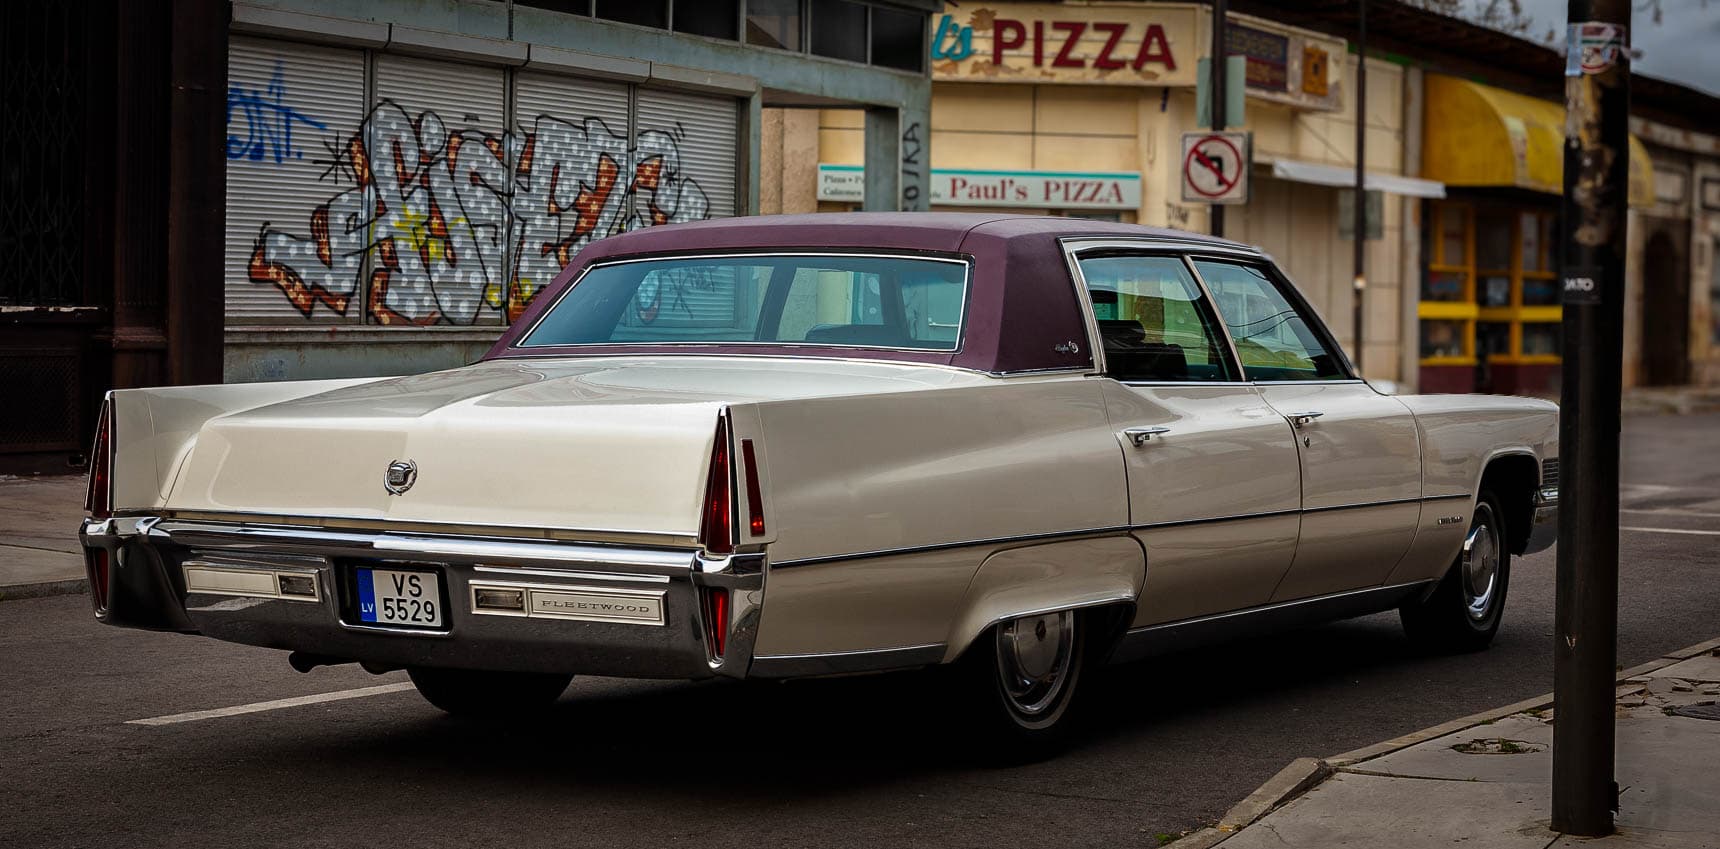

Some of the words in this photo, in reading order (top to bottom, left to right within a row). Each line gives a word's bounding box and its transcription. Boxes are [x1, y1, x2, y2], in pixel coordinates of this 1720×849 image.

[992, 19, 1177, 71] PIZZA
[950, 177, 1028, 201] Paul's
[1044, 180, 1125, 203] PIZZA
[391, 573, 422, 597] VS
[361, 602, 374, 613] LV
[383, 597, 436, 622] 5529
[541, 600, 650, 613] FLEETWOOD
